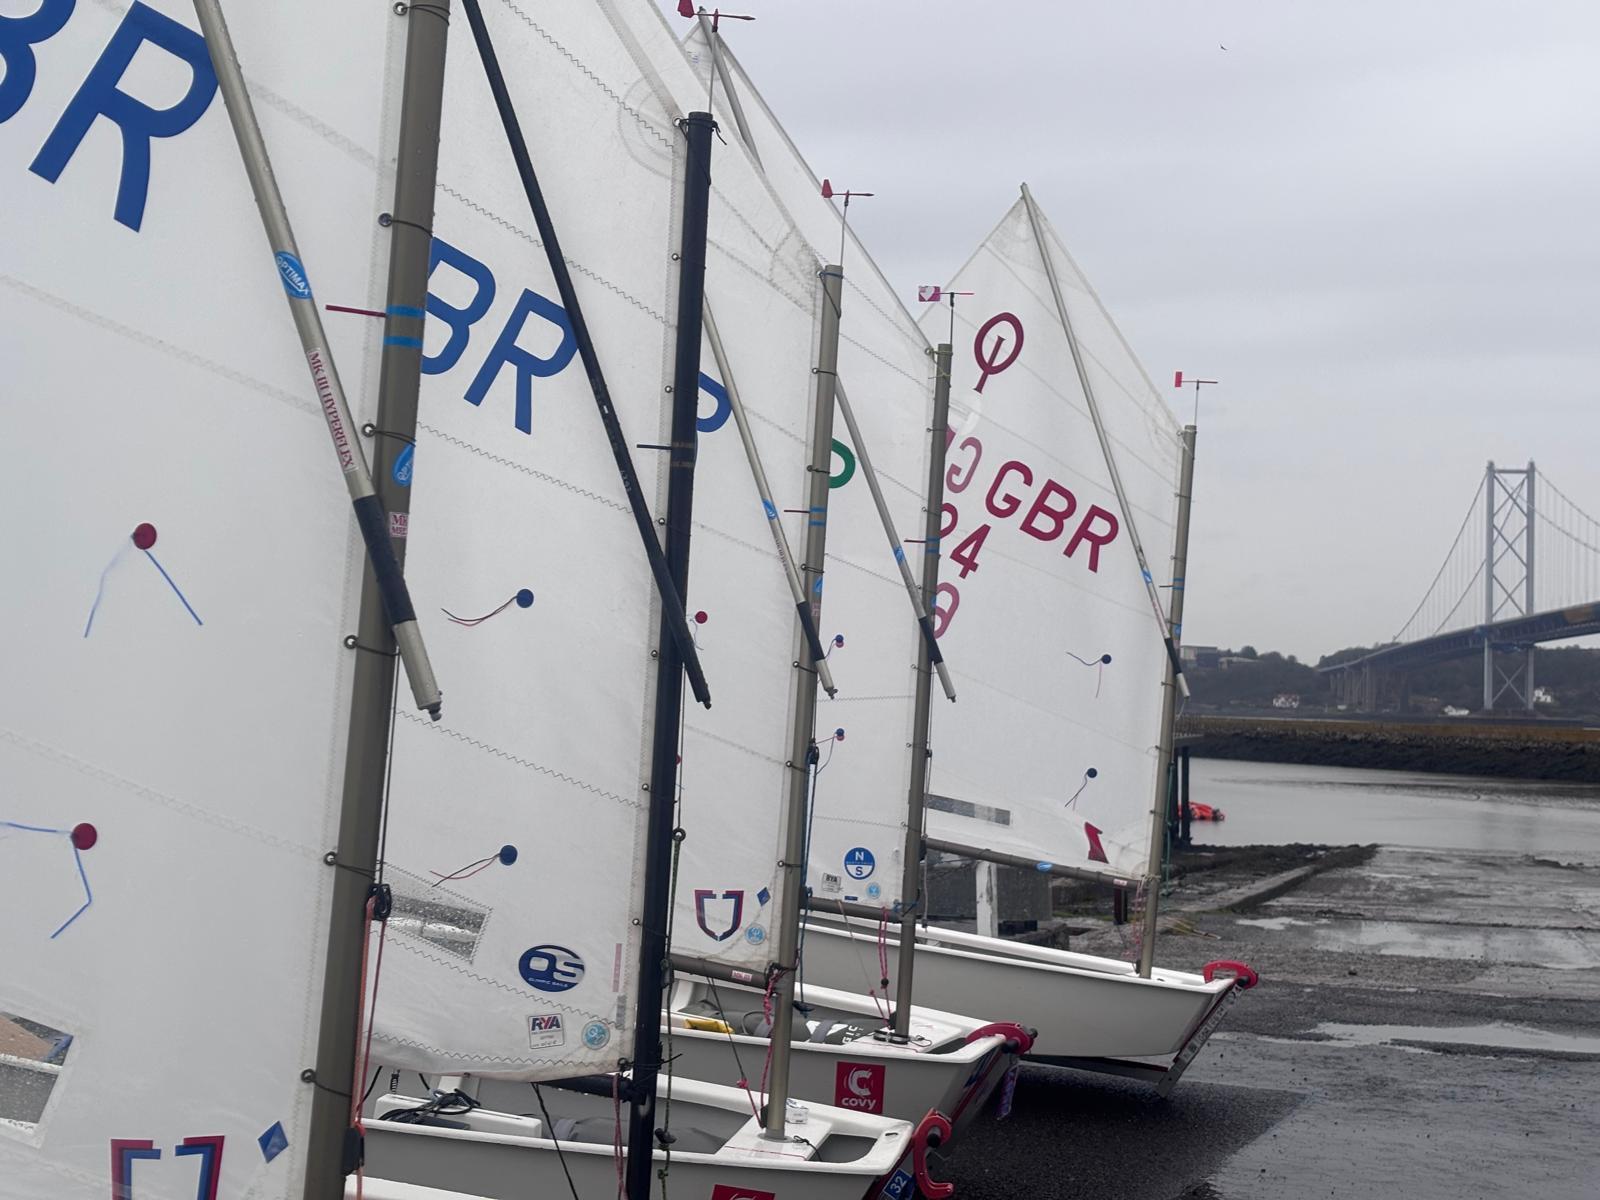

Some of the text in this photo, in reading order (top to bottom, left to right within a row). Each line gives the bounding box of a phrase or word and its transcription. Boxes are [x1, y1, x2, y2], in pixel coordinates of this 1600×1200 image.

[420, 236, 579, 434] BR
[308, 350, 354, 467] MK III HYPERFLEX
[985, 460, 1119, 574] GBR
[855, 851, 865, 861] N
[855, 865, 864, 876] S
[531, 1015, 561, 1032] RYA
[890, 1176, 908, 1194] 32
